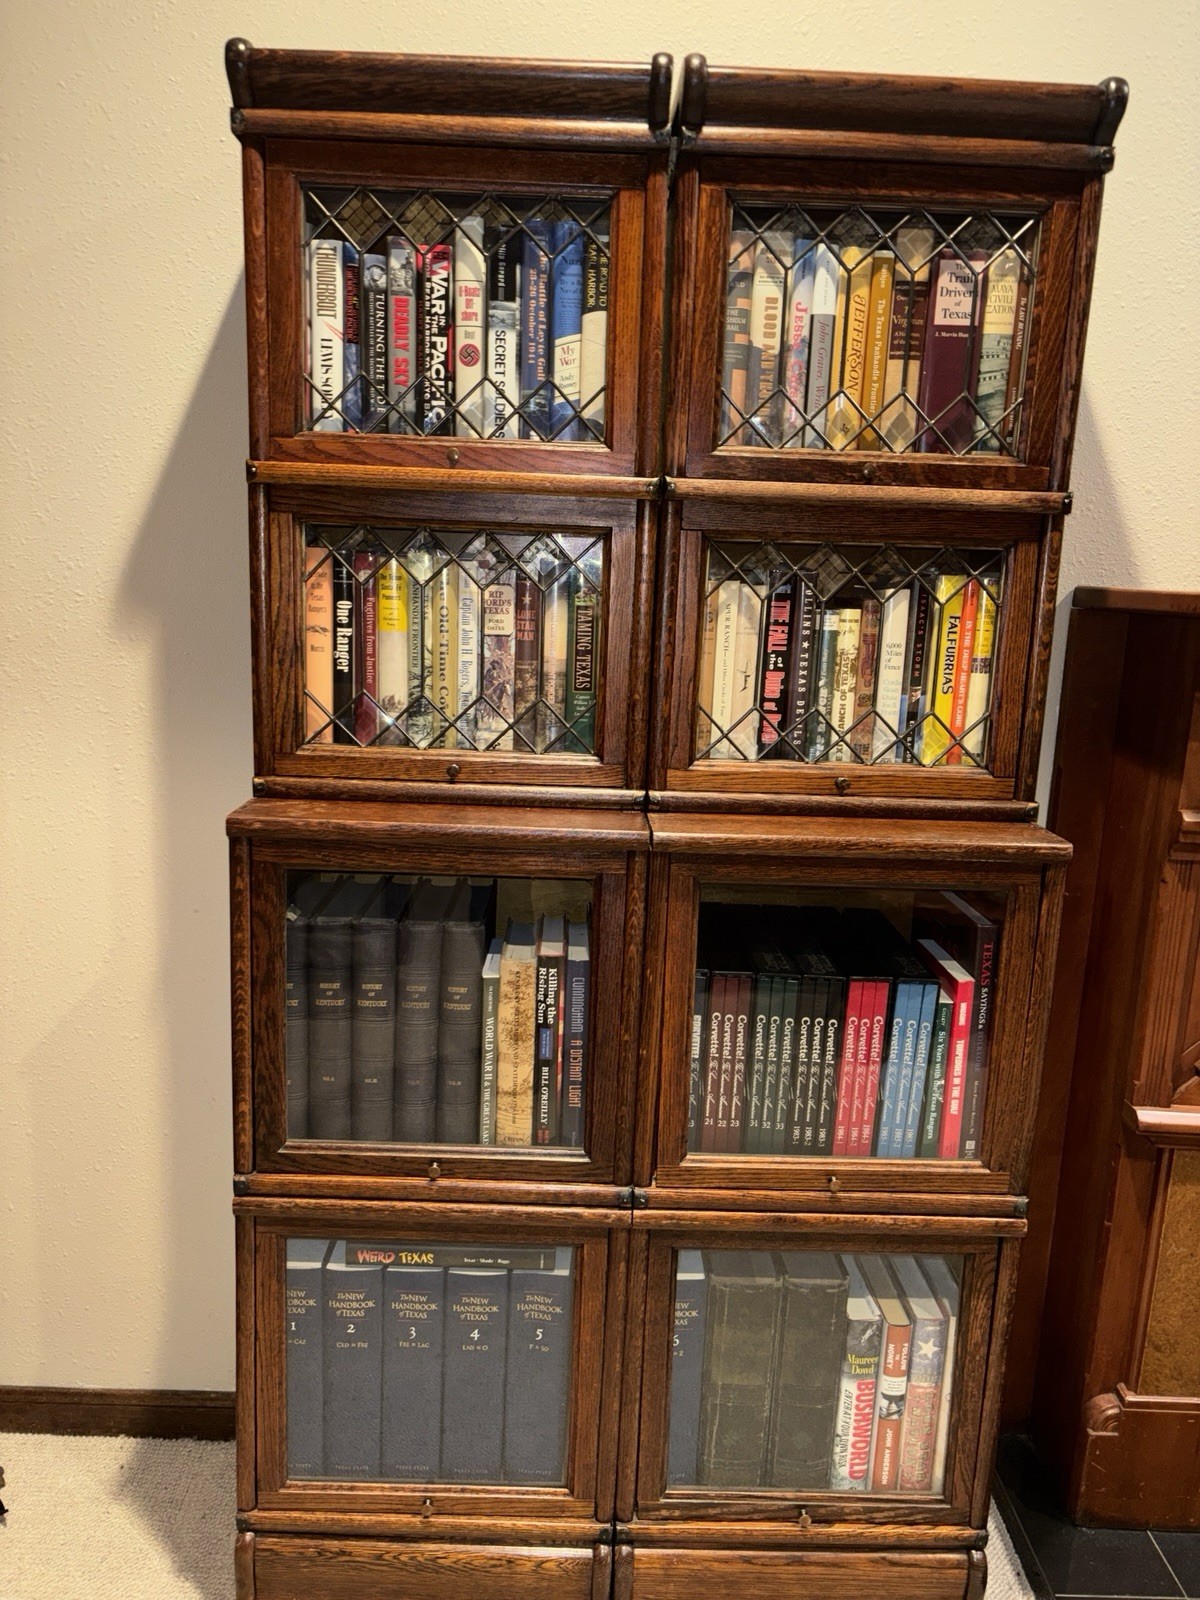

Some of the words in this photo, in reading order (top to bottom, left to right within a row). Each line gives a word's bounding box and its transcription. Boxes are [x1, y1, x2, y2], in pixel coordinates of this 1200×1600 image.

[316, 246, 337, 319] THUNDERBOLT
[431, 259, 447, 314] WAR
[538, 274, 547, 308] Battle
[599, 267, 608, 292] ROAD
[948, 272, 974, 283] Trail
[599, 295, 607, 306] TO
[877, 299, 886, 314] The
[942, 308, 972, 319] Texas
[376, 294, 385, 352] TURNING
[394, 297, 410, 352] DEADLY
[439, 316, 445, 326] IN
[528, 299, 536, 339] October
[538, 311, 546, 322] of
[763, 297, 778, 339] BLOOD
[875, 316, 884, 339] Texas
[536, 324, 546, 354] Leyte
[818, 319, 829, 345] John
[320, 338, 333, 374] LEWIS
[495, 330, 506, 378] SECRET
[559, 357, 577, 367] War
[761, 344, 775, 369] AND
[871, 341, 882, 381] Panhandle
[376, 356, 384, 380] THE
[394, 357, 410, 388] SKY
[376, 384, 384, 413] TDE
[870, 383, 879, 414] Frontier
[336, 600, 353, 624] One
[364, 597, 375, 633] Fugitives
[460, 598, 473, 625] Captain
[484, 607, 510, 615] TEXAS
[517, 610, 535, 619] LONE
[771, 600, 791, 623] THE
[917, 594, 927, 635] ISAAC'S
[461, 628, 473, 646] John
[516, 620, 535, 630] STAR
[516, 631, 534, 641] MAN
[577, 609, 593, 650] TAMING
[965, 620, 972, 630] IN
[334, 627, 353, 673] Ranger
[366, 636, 374, 654] from
[439, 605, 449, 681] Old-Time
[767, 625, 790, 653] FALL
[963, 632, 971, 646] THE
[777, 657, 783, 667] of
[913, 643, 922, 677] STORM
[941, 615, 962, 695] FALFURRIAS
[961, 649, 970, 671] DEEP
[366, 656, 374, 683] Justice
[576, 655, 590, 688] TEXAS
[797, 653, 809, 693] TEXAS
[840, 655, 850, 687] TEXAS
[764, 671, 785, 699] Duke
[840, 688, 847, 701] OF
[957, 672, 967, 705] HEART'S
[764, 702, 777, 711] of
[955, 706, 964, 727] CORE
[980, 941, 994, 986] TEXAS
[536, 967, 547, 1000] Rising
[547, 968, 557, 1005] Killing
[547, 1007, 556, 1024] the
[571, 977, 585, 1032] CUNNINGHAM
[978, 987, 988, 1024] SAYINGS
[484, 1017, 495, 1051] WORLD
[710, 1012, 721, 1057] Corvette!
[723, 1014, 734, 1059] Corvette!
[735, 1015, 747, 1059] Corvette!
[754, 1014, 766, 1059] Corvette!
[768, 1016, 780, 1061] Corvette!
[782, 1017, 794, 1062] Corvette!
[799, 1017, 810, 1062] Corvette!
[812, 1017, 824, 1062] Corvette!
[825, 1019, 838, 1064] Corvette!
[845, 1017, 858, 1062] Corvette!
[858, 1019, 870, 1063] Corvette!
[870, 1016, 883, 1061] Corvette!
[890, 1018, 903, 1062] Corvette!
[903, 1020, 917, 1065] Corvette!
[917, 1022, 931, 1066] Corvette!
[937, 1031, 946, 1043] Six
[484, 1052, 494, 1071] WAR
[569, 1049, 582, 1081] DISTANT
[935, 1044, 944, 1062] Years
[953, 1040, 964, 1077] TORPEDOES
[974, 1031, 984, 1073] FOLKLORE
[541, 1066, 549, 1087] BILL
[934, 1063, 942, 1078] with
[540, 1087, 549, 1124] O'REILLY
[569, 1085, 581, 1107] LIGHT
[952, 1086, 961, 1098] THE
[950, 1100, 960, 1115] GULF
[927, 1112, 936, 1139] Rangers
[329, 1300, 375, 1308] HANDBOOK
[391, 1302, 438, 1311] HANDBOOK
[409, 1294, 428, 1302] NEW
[517, 1304, 562, 1313] HANDBOOK
[534, 1296, 553, 1304] NEW
[291, 1322, 296, 1330] 1
[347, 1324, 355, 1333] 2
[531, 1312, 552, 1320] TEXAS
[409, 1326, 416, 1339] 3
[470, 1328, 480, 1340] 4
[535, 1329, 543, 1340] 5
[848, 1354, 879, 1364] Maureen
[886, 1343, 894, 1368] MONEY
[900, 1343, 908, 1370] FOLLOW
[852, 1365, 874, 1375] Dowd
[844, 1390, 853, 1411] ENTER
[840, 1420, 848, 1437] YOUR
[849, 1378, 876, 1480] BUSHWORLD
[839, 1438, 848, 1454] OWN
[882, 1448, 892, 1485] ANDERSON
